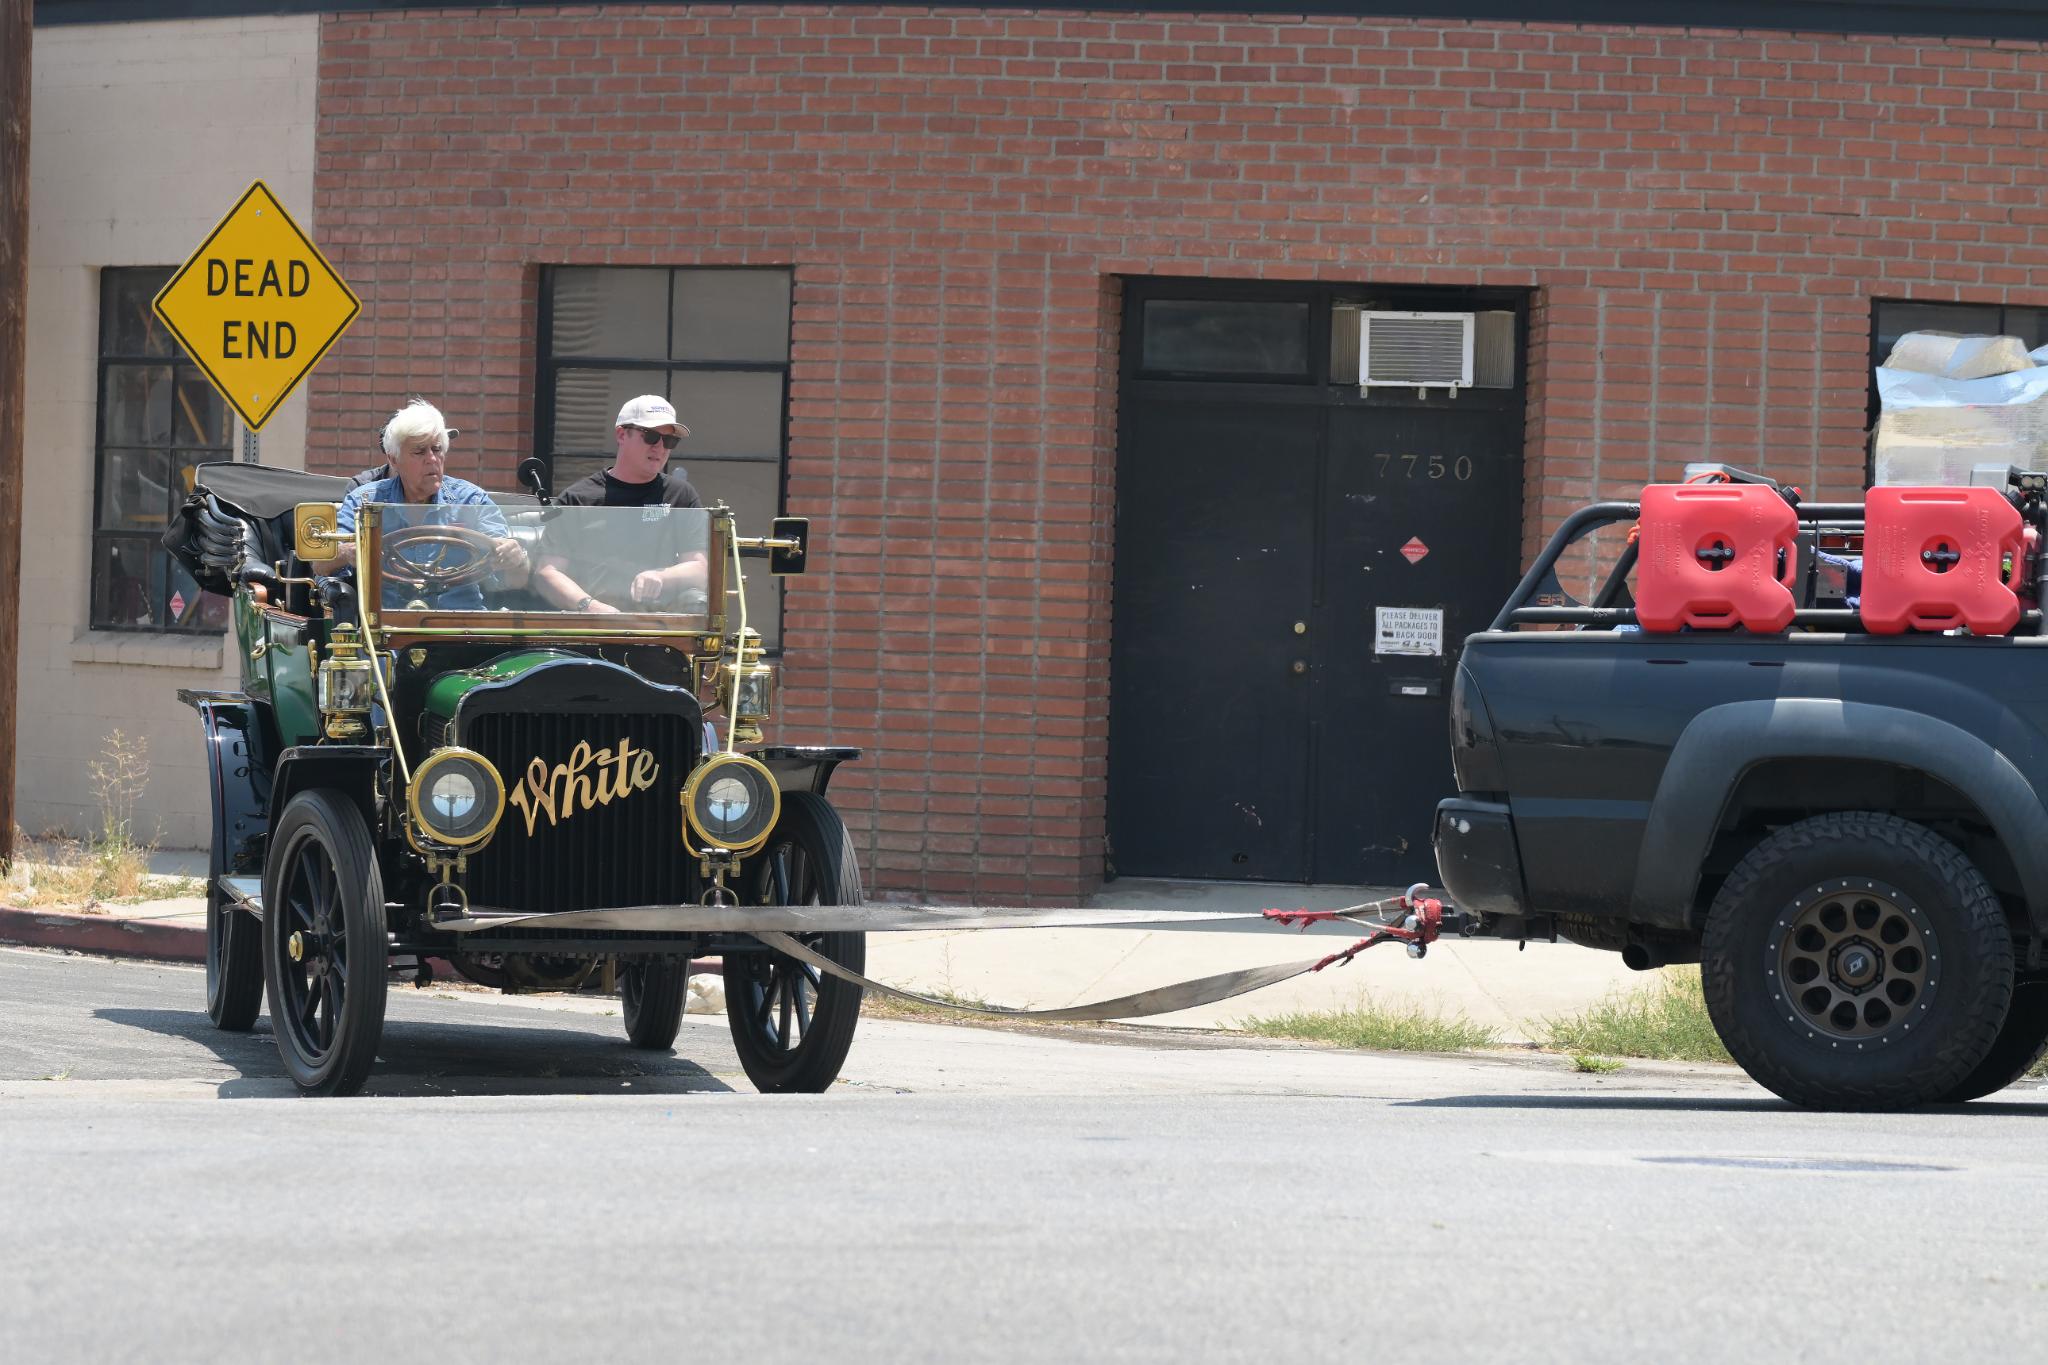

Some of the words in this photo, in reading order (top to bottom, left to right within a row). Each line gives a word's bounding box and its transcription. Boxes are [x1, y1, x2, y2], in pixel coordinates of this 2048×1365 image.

[207, 259, 310, 297] DEAD
[223, 321, 297, 359] END
[1374, 453, 1473, 481] 7750
[1381, 611, 1407, 620] PLEASE
[1409, 611, 1438, 621] DELIVER
[1381, 620, 1393, 629] ALL
[1394, 621, 1428, 630] PACKAGES
[1429, 622, 1438, 631] TO
[1395, 631, 1416, 639] BACK
[1417, 631, 1437, 640] DOOR
[509, 736, 660, 837] White
